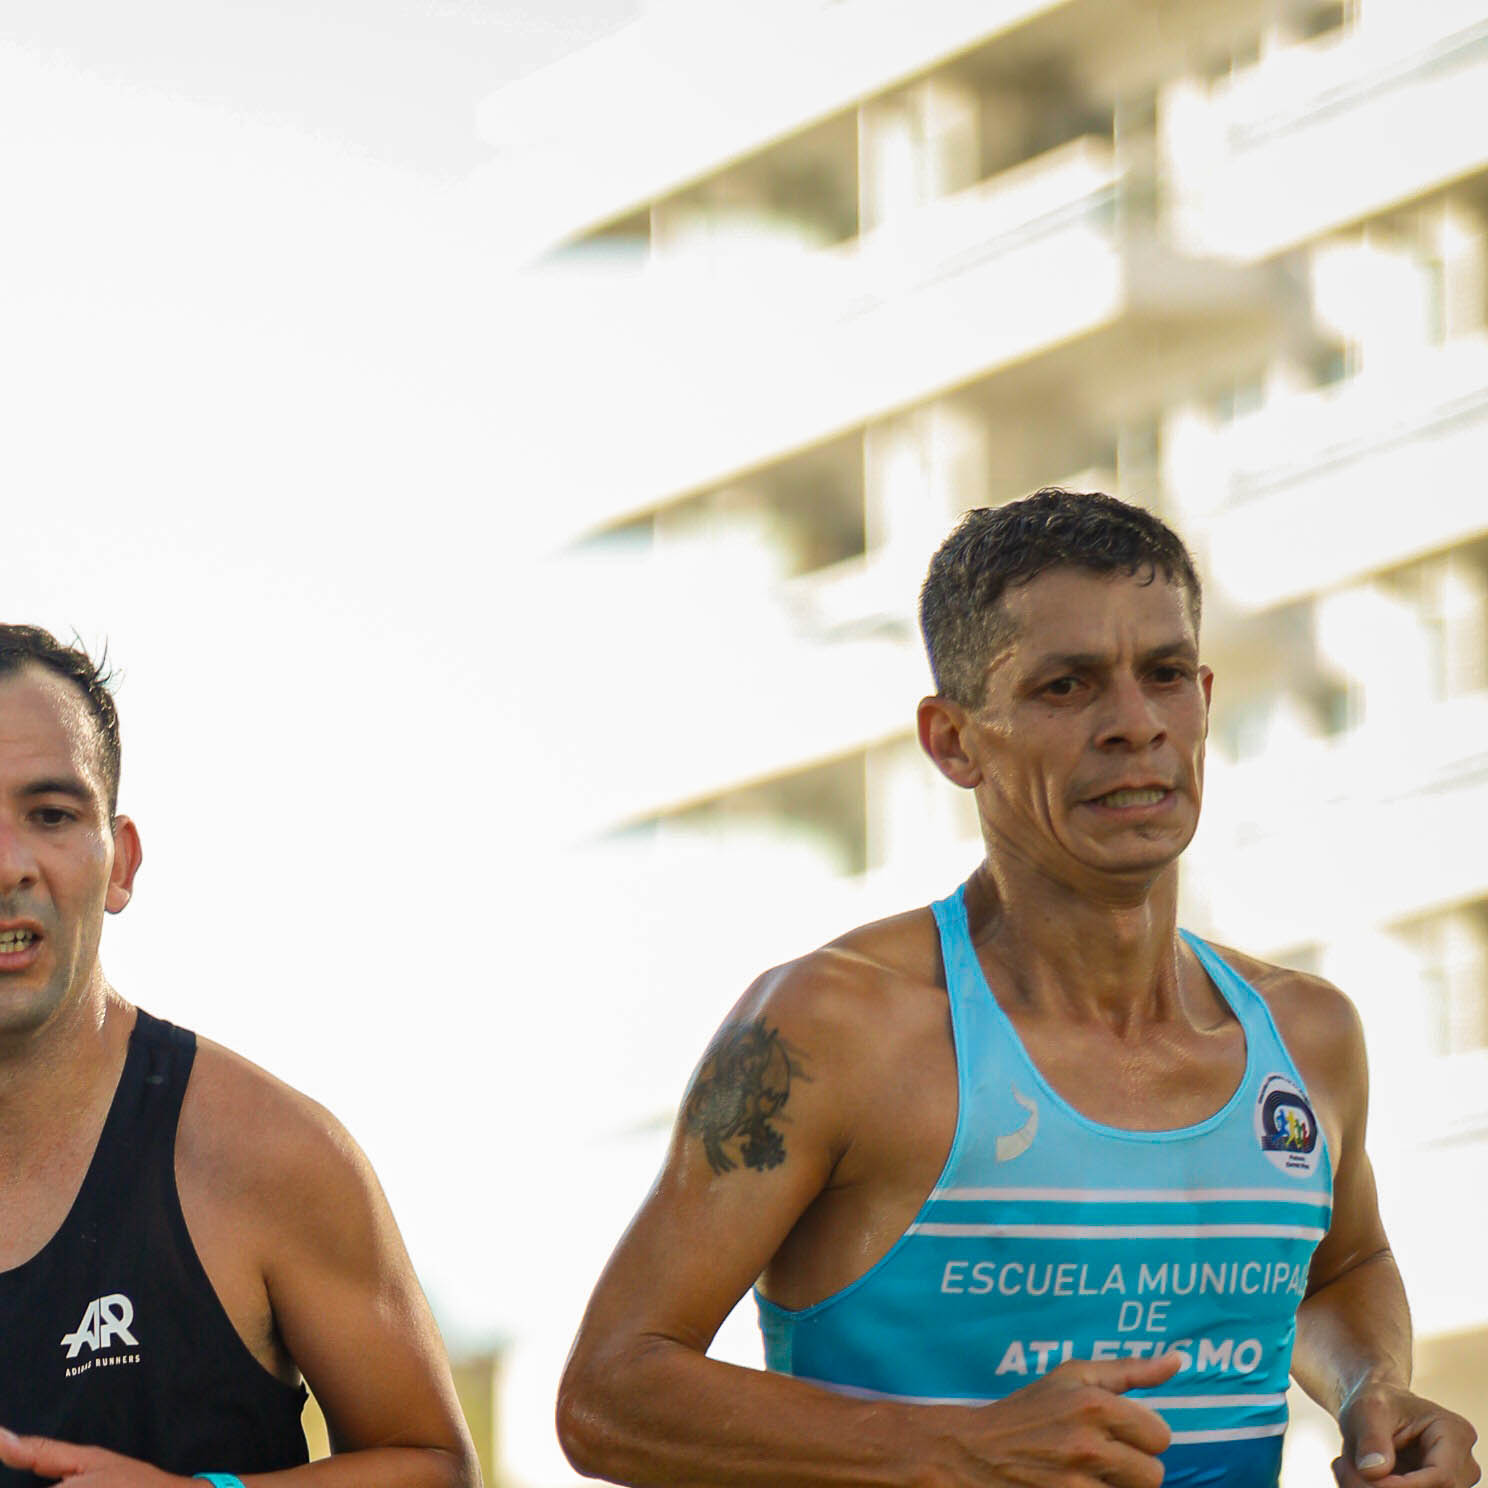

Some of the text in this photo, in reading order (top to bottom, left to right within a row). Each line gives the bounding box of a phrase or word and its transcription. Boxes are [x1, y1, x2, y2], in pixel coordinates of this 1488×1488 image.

[940, 1261, 1127, 1296] ESCUELA
[60, 1293, 139, 1359] AR
[1117, 1301, 1172, 1333] DE
[95, 1354, 141, 1368] RUNNERS
